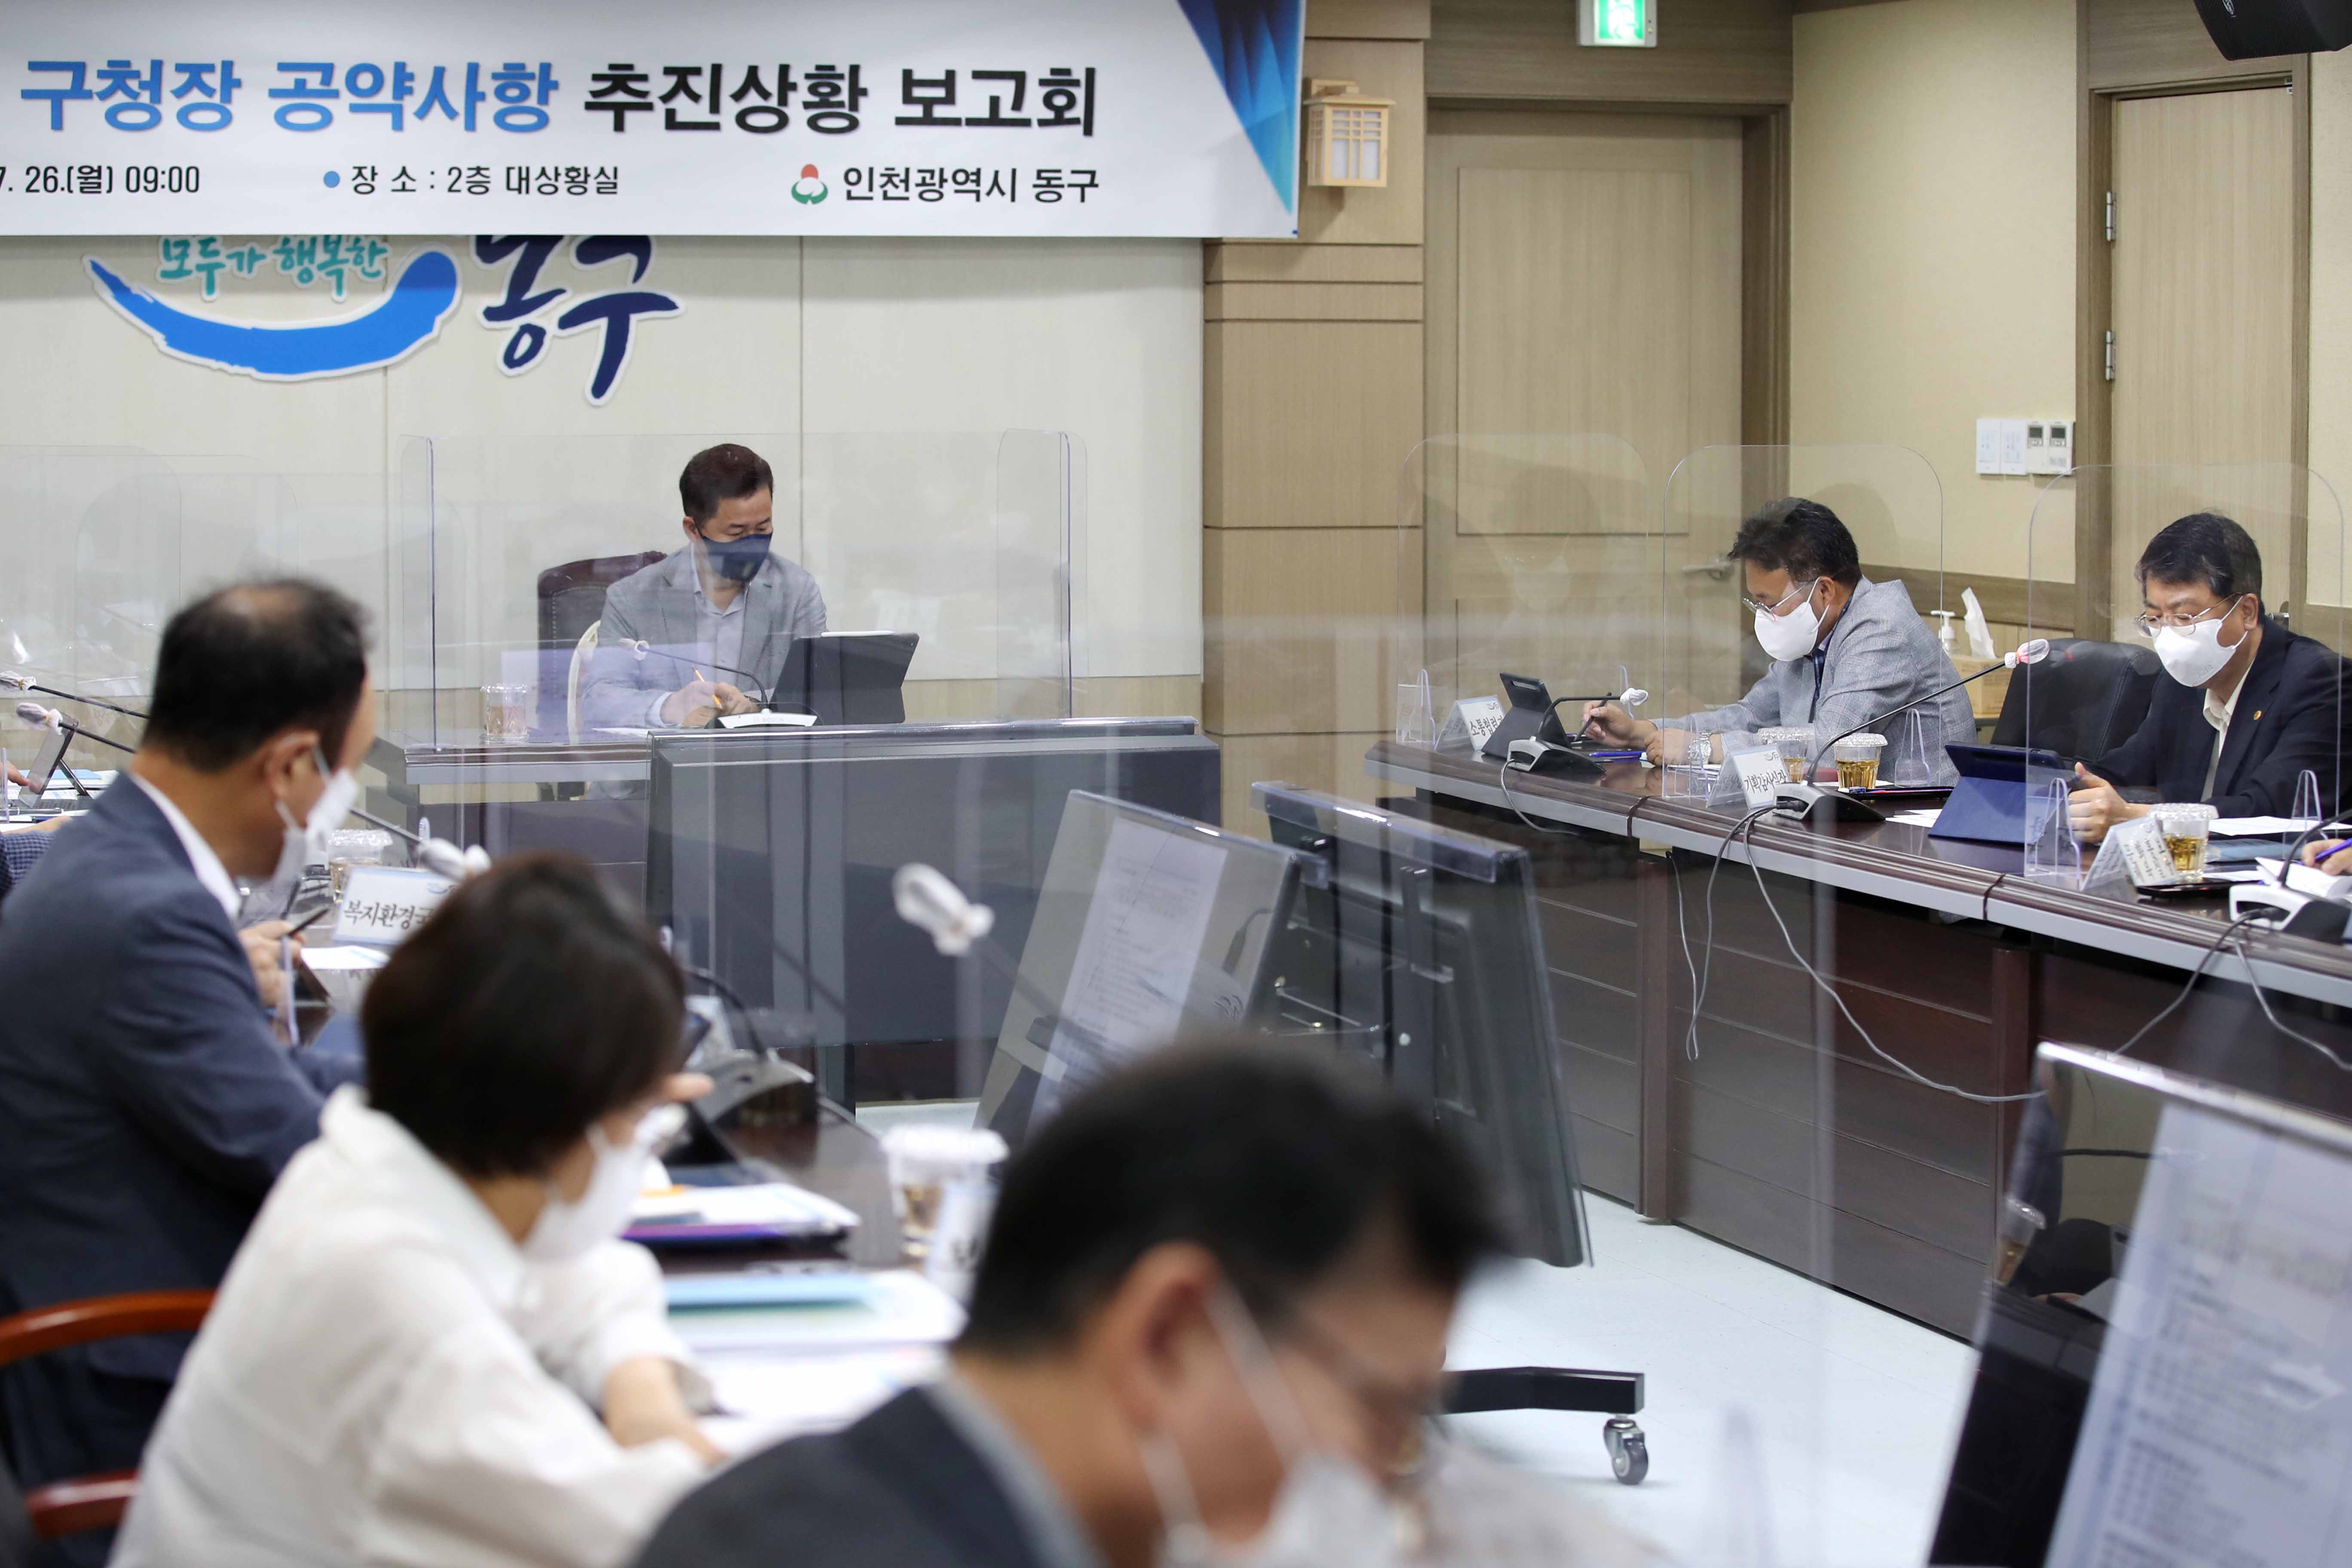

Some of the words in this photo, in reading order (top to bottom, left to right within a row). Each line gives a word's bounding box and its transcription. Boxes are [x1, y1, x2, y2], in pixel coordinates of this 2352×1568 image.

[21, 59, 241, 131] 구청장
[268, 61, 558, 132] 공약사항
[584, 63, 868, 134] 추진상황
[895, 67, 1096, 137] 보고회
[25, 165, 113, 194] 26.(월)
[126, 166, 199, 193] 09:00
[352, 165, 378, 195] 장
[391, 166, 416, 192] 소
[447, 165, 491, 195] 2층
[506, 166, 618, 196] 대상황실
[844, 167, 1017, 202] 인천광역시
[1032, 169, 1099, 203] 동구
[160, 236, 266, 296] 모두가
[273, 235, 388, 296] 행복한
